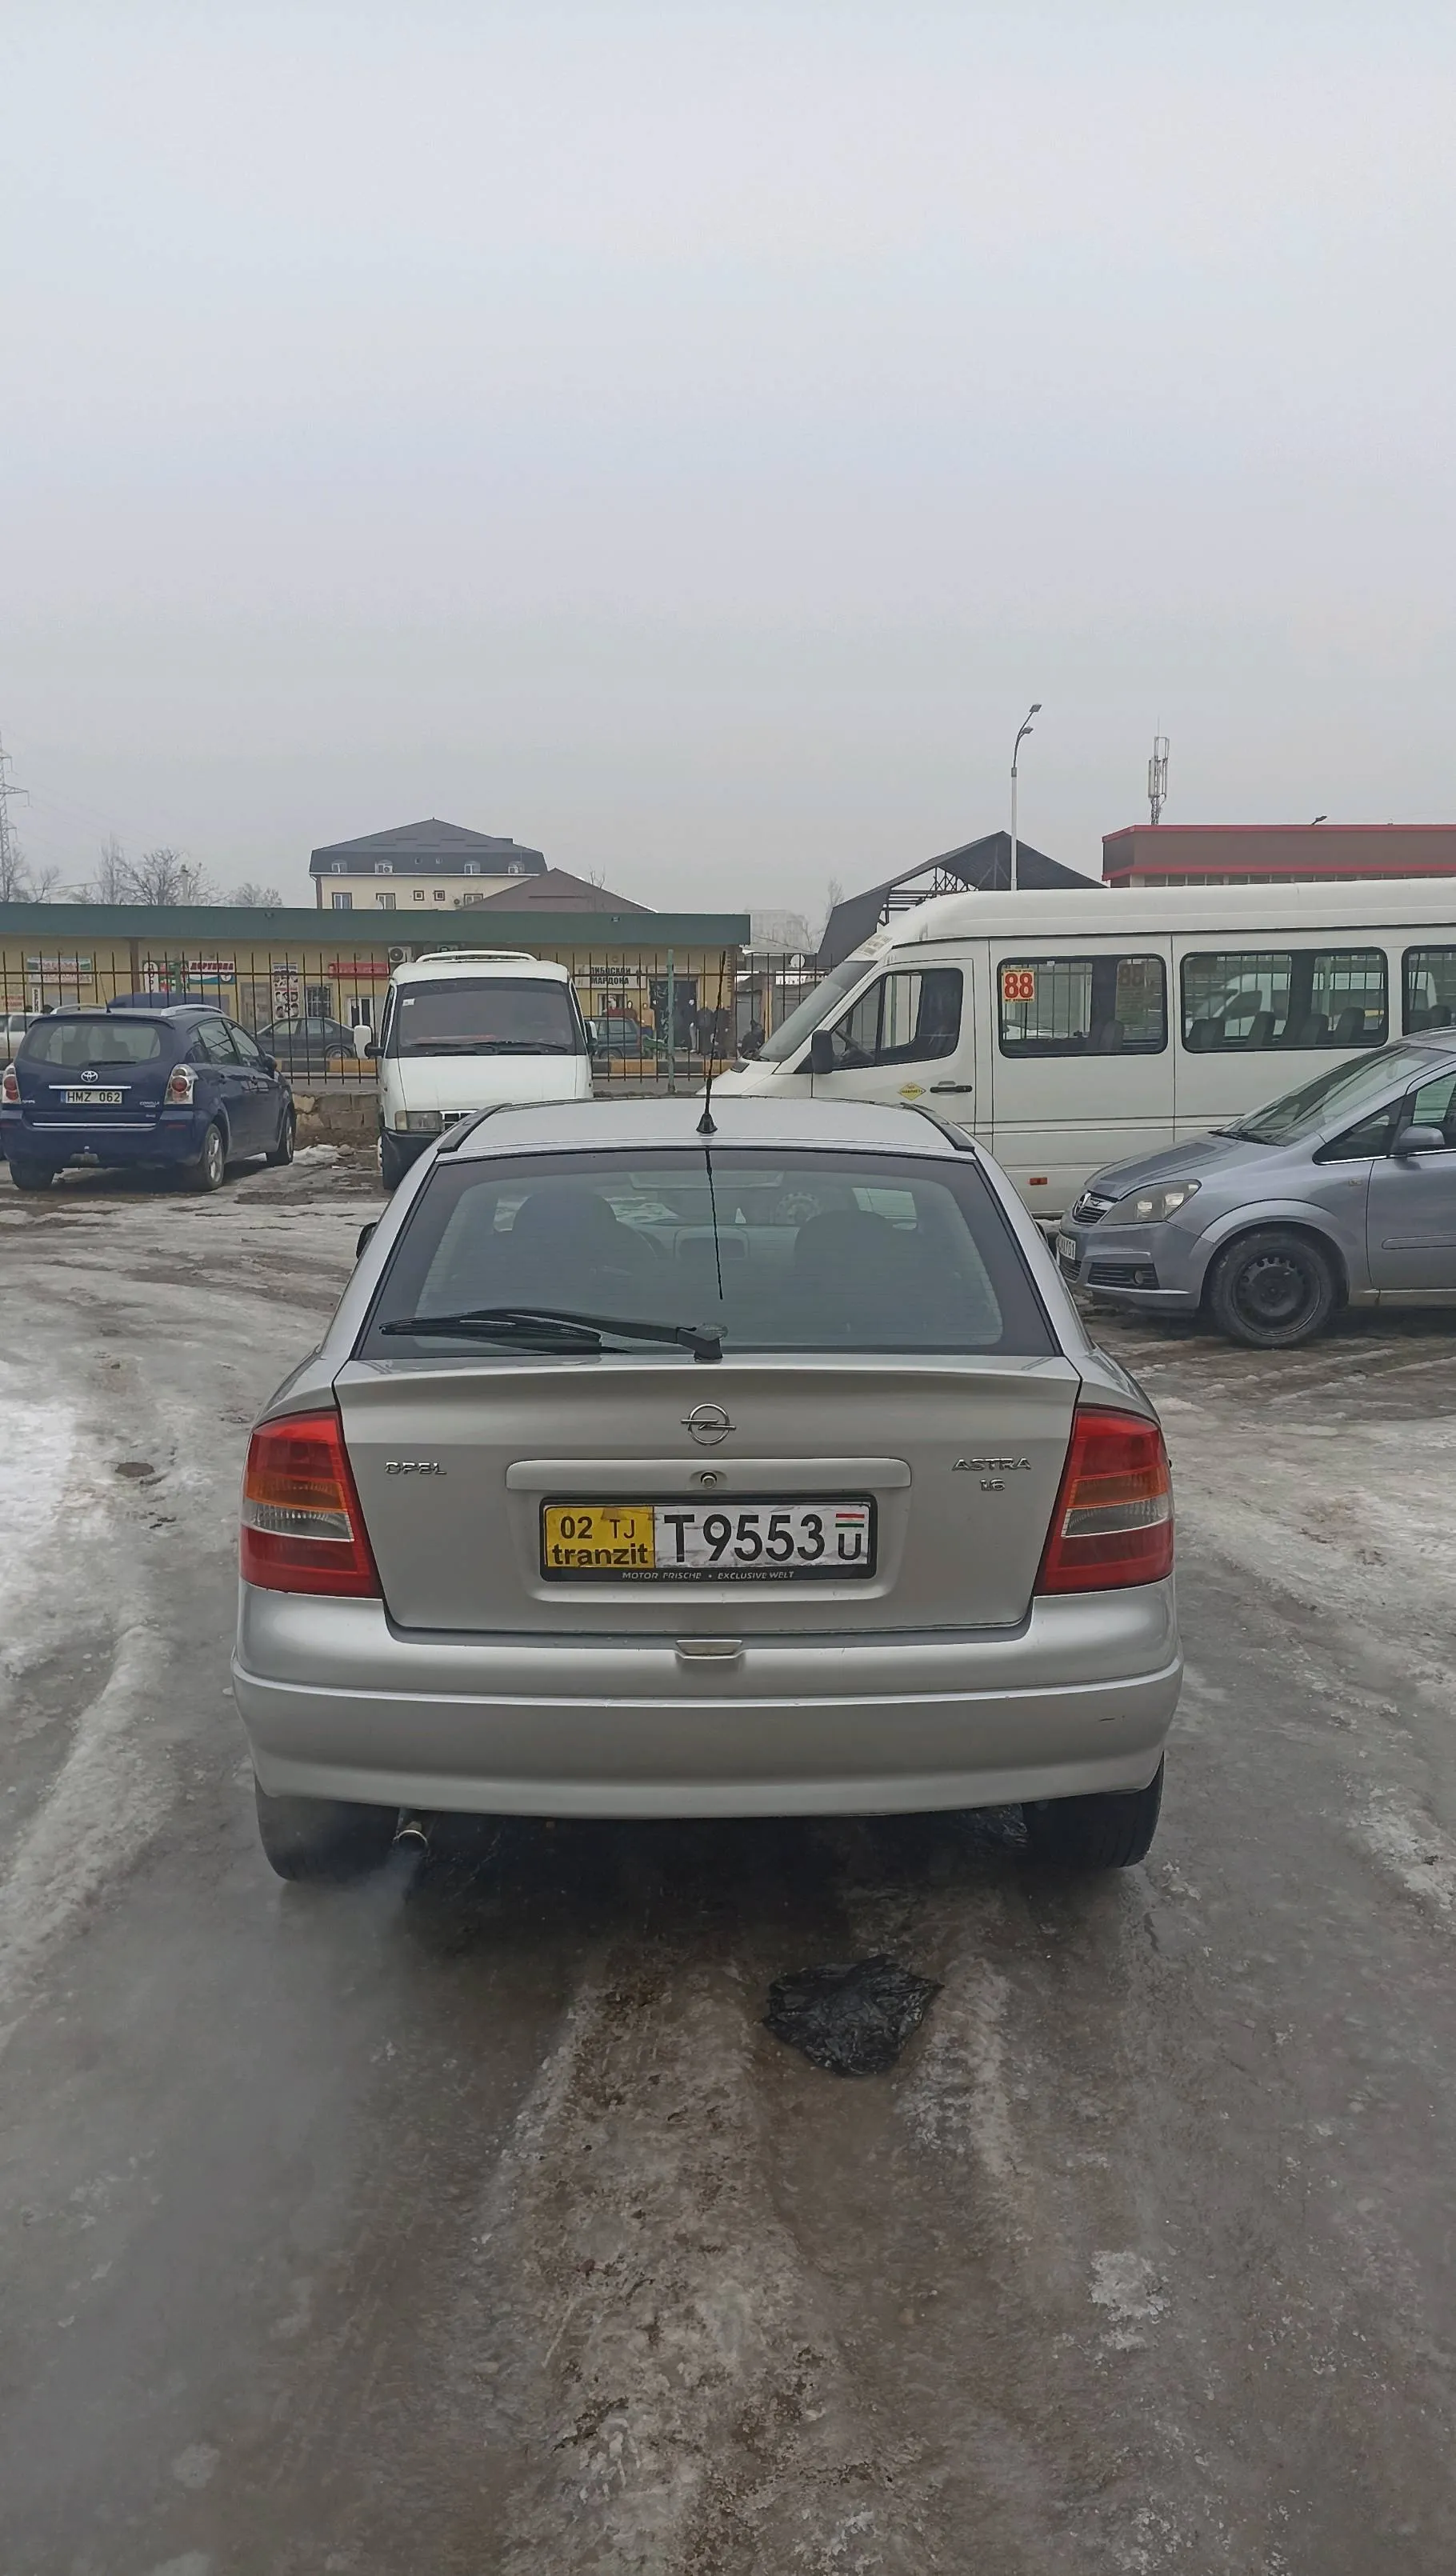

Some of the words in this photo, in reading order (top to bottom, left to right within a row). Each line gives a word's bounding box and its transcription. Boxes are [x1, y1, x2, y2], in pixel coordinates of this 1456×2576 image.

[1005, 973, 1033, 998] 88
[67, 1091, 91, 1102] HMZ
[99, 1091, 120, 1102] 062
[385, 1462, 447, 1474] OPEL
[952, 1458, 1031, 1471] ASTRA
[560, 1515, 593, 1539] 02
[609, 1518, 635, 1539] TJ
[663, 1513, 826, 1562] T9553
[838, 1533, 862, 1561] U
[552, 1542, 648, 1566] tranzit
[718, 1572, 767, 1580] EXCLUSIVE
[769, 1570, 794, 1578] WELT
